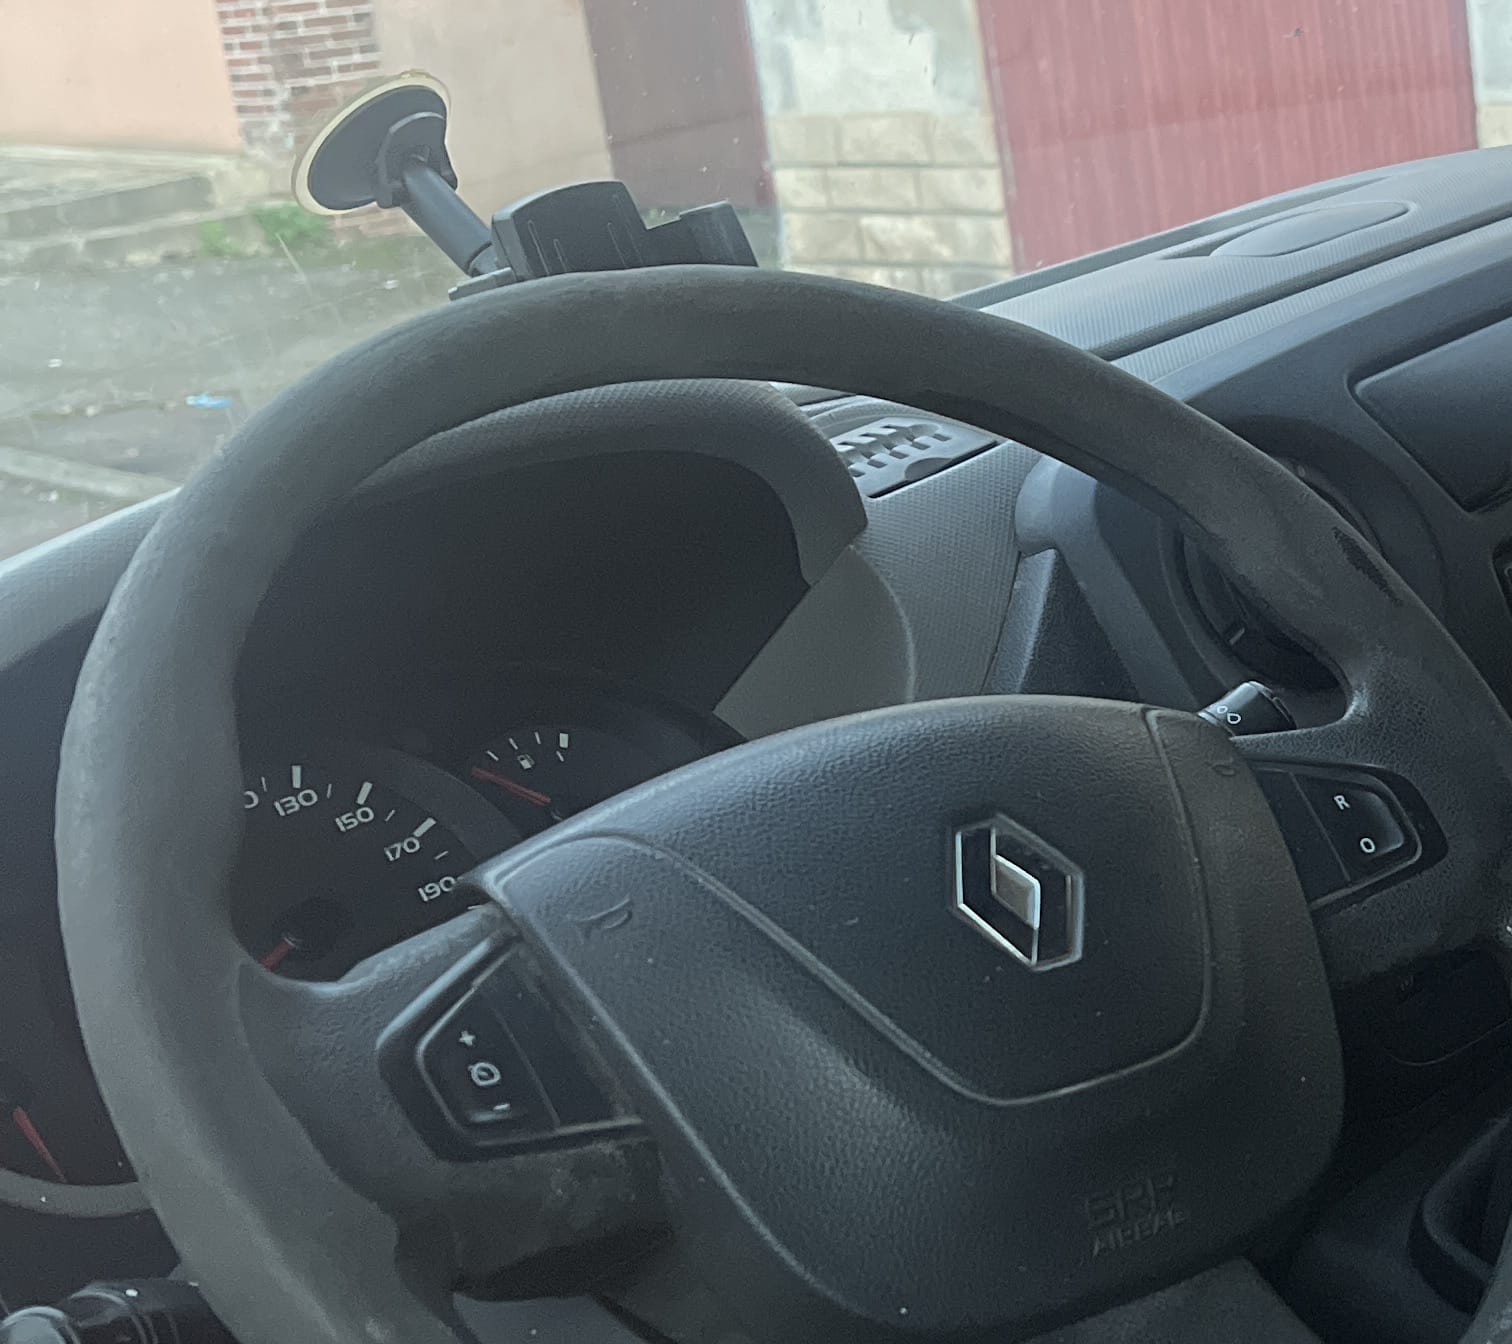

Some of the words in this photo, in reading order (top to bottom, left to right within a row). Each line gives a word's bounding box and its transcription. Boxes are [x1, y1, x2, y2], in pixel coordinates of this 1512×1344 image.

[274, 788, 319, 817] 130
[1333, 794, 1351, 811] R
[335, 806, 375, 833] 150
[383, 836, 421, 862] 170
[417, 875, 457, 903] 190
